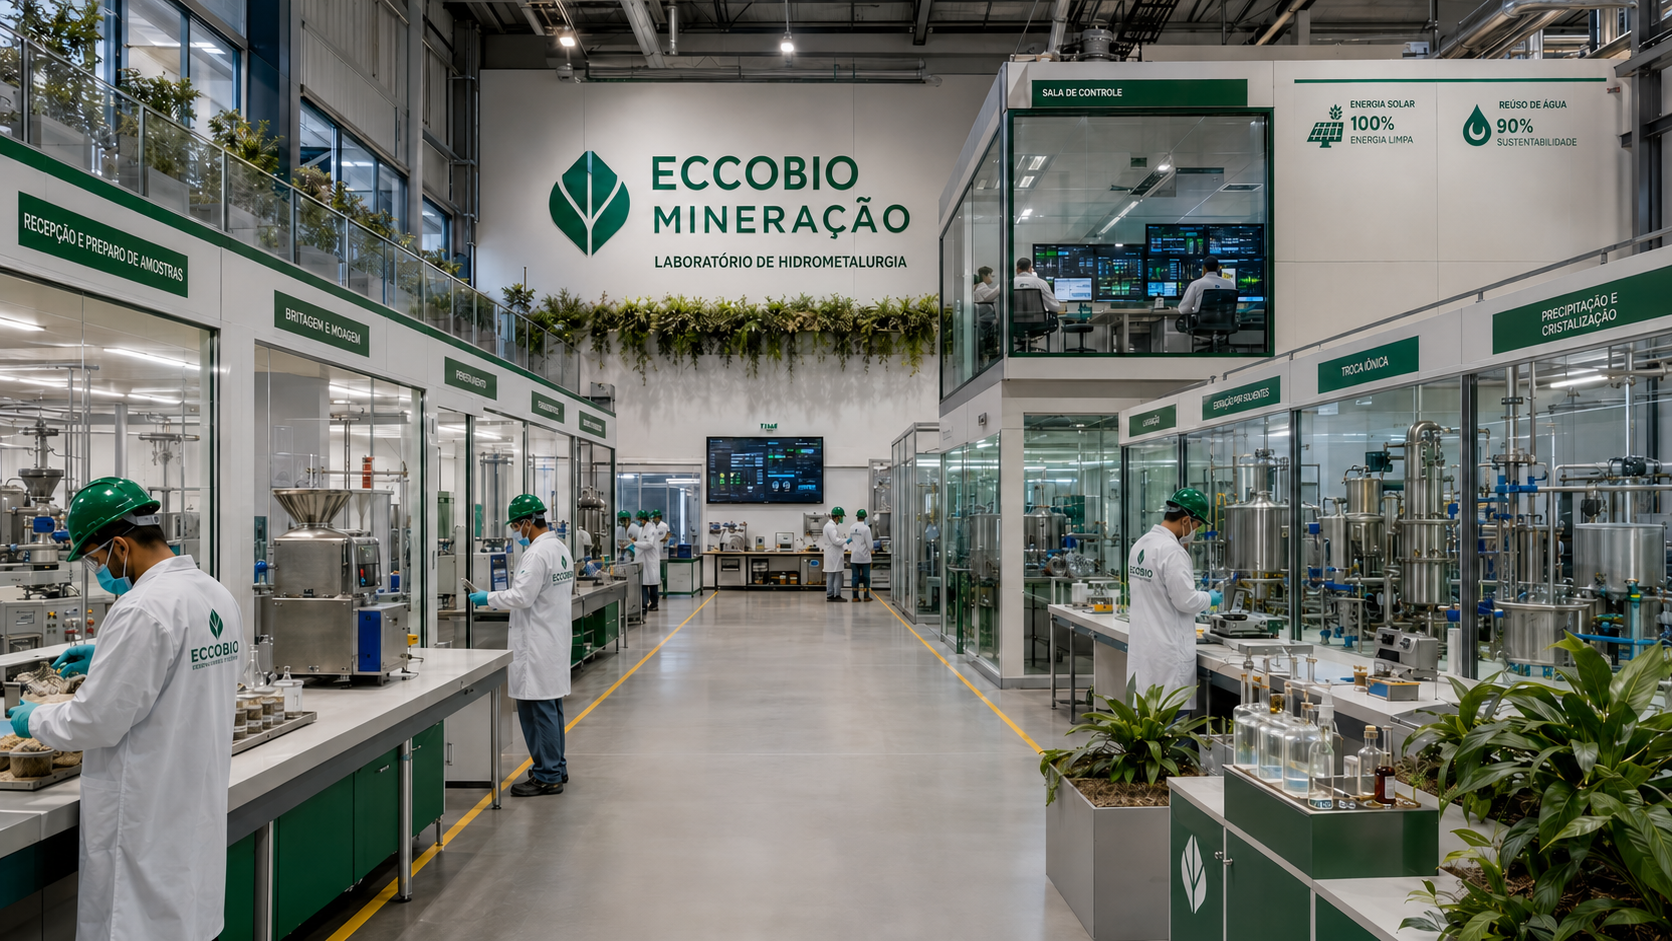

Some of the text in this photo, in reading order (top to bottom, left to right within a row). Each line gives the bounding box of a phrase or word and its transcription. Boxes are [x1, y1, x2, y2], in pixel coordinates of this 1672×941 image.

[1042, 88, 1122, 97] SALA DE CONTROLE
[1350, 100, 1415, 109] ENERGIA SOLAR
[1499, 99, 1567, 109] REÚSO DE ÁGUA
[1350, 116, 1394, 131] 100%
[1497, 118, 1533, 134] 90%
[1350, 136, 1413, 144] ENERGIA LIMPA
[1497, 138, 1577, 147] SUSTENTABILIDADE
[652, 155, 859, 191] ECCOBIO
[653, 196, 910, 239] MINERAÇÃO
[24, 212, 183, 282] RECEPÇÃO E PREPARO DE AMOSTRAS
[654, 253, 907, 268] LABORATÓRIO DE HIDROMETALURGIA
[1542, 292, 1618, 322] PRECIPITAÇÃO E
[285, 307, 361, 345] BRITAGEM E MOAGEM
[1542, 308, 1617, 336] CRISTALIZAÇÃO
[1341, 363, 1364, 377] TROCA
[191, 640, 239, 663] ECCOBIO
